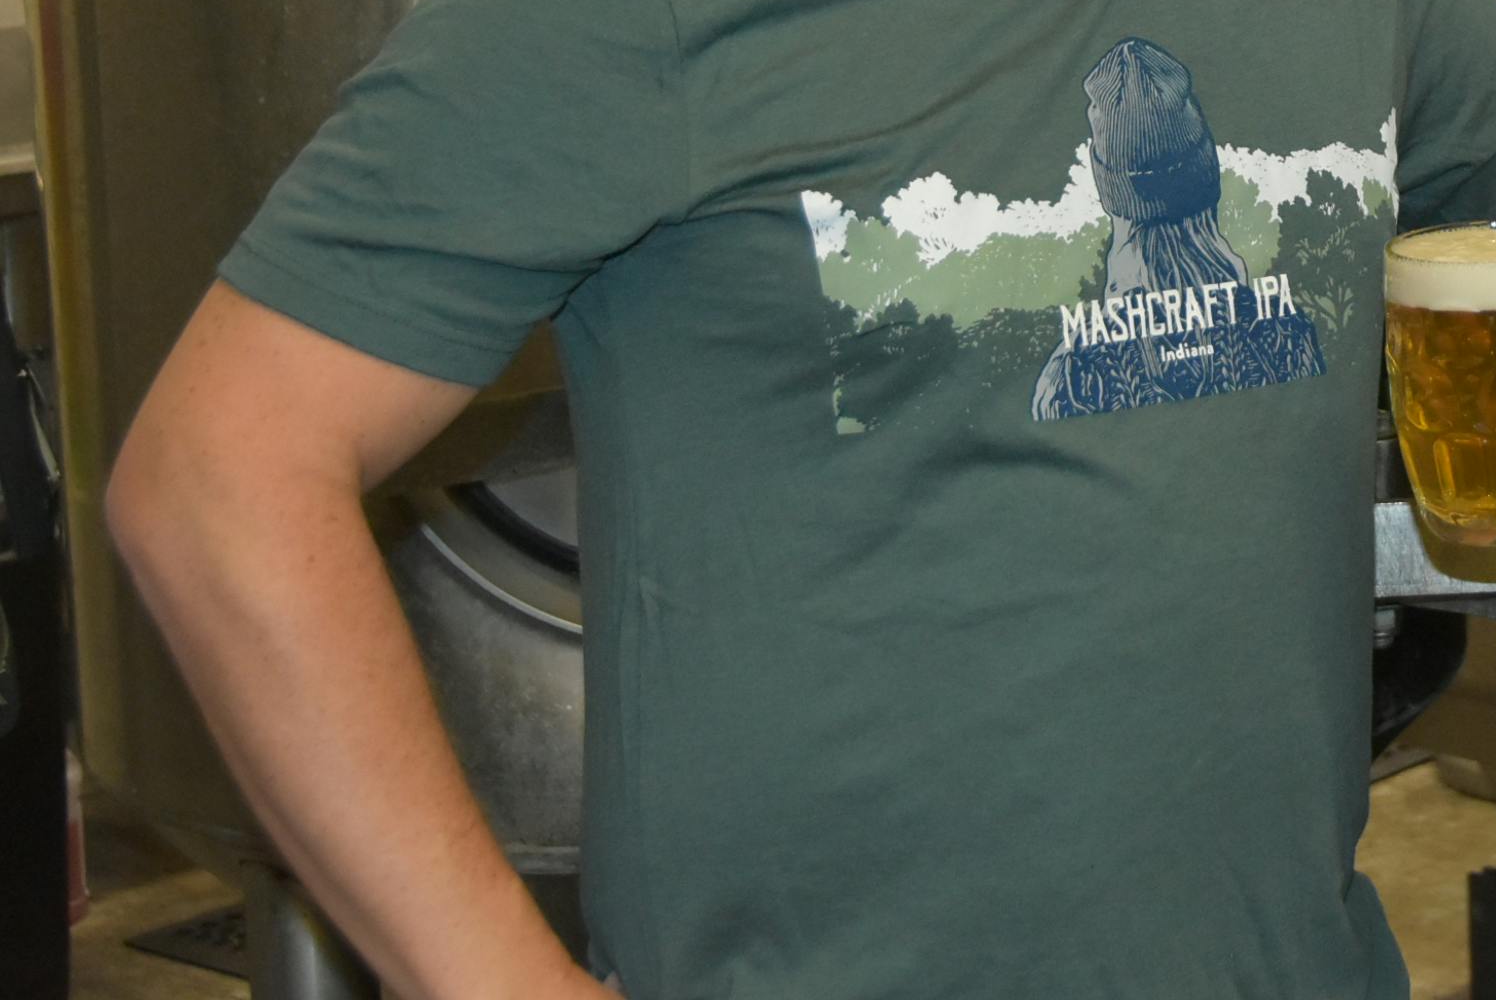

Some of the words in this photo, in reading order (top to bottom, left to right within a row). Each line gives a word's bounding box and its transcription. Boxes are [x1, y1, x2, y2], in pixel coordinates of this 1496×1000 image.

[1059, 281, 1240, 349] MASHCRAFT
[1252, 273, 1297, 320] IPA
[1160, 341, 1215, 363] Indiana
